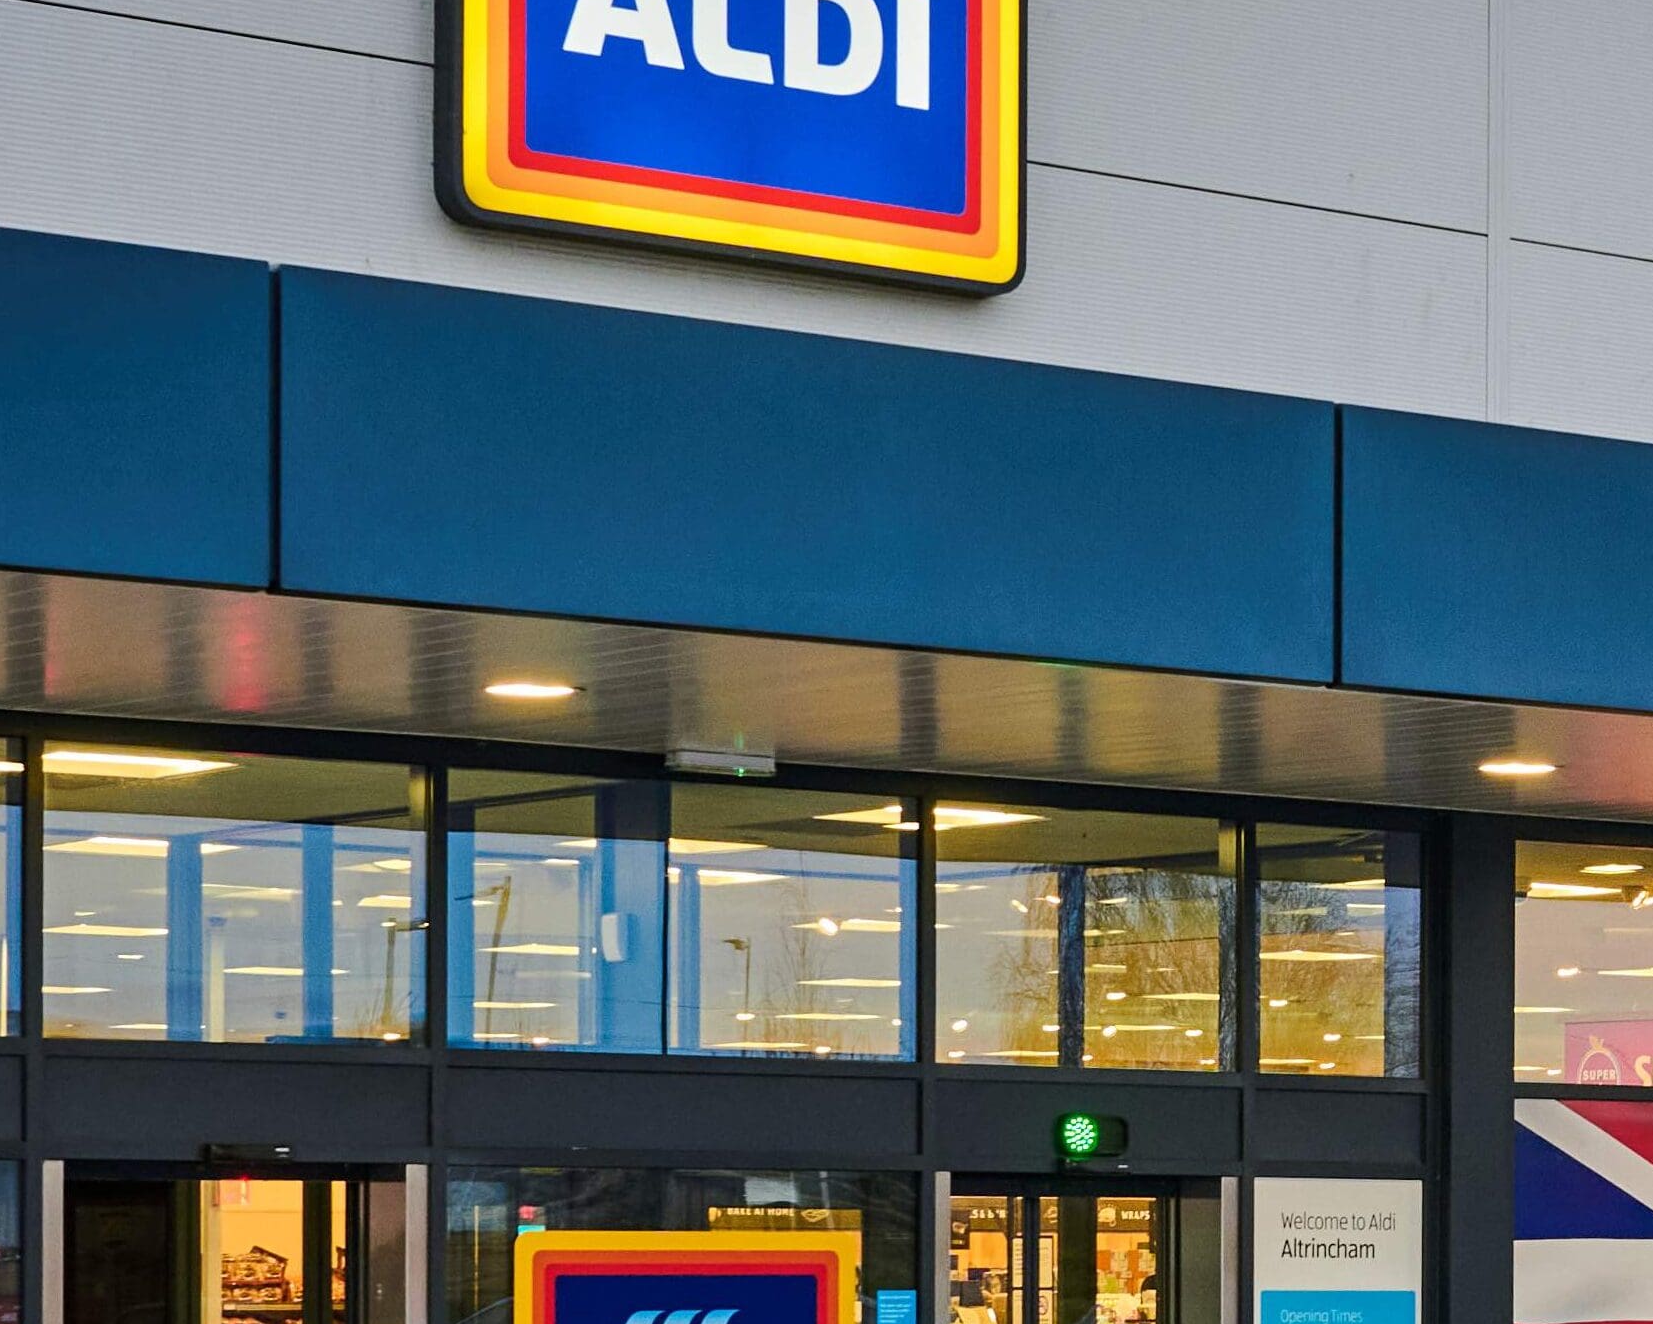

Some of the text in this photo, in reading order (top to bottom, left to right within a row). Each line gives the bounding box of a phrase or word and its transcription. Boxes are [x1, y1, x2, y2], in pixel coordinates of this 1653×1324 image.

[1583, 1068, 1616, 1081] SUPER
[1121, 1209, 1151, 1221] WRAPS
[1281, 1211, 1396, 1231] Welcome to Aldi
[1281, 1237, 1376, 1259] Altrincham
[1331, 1308, 1363, 1323] Times
